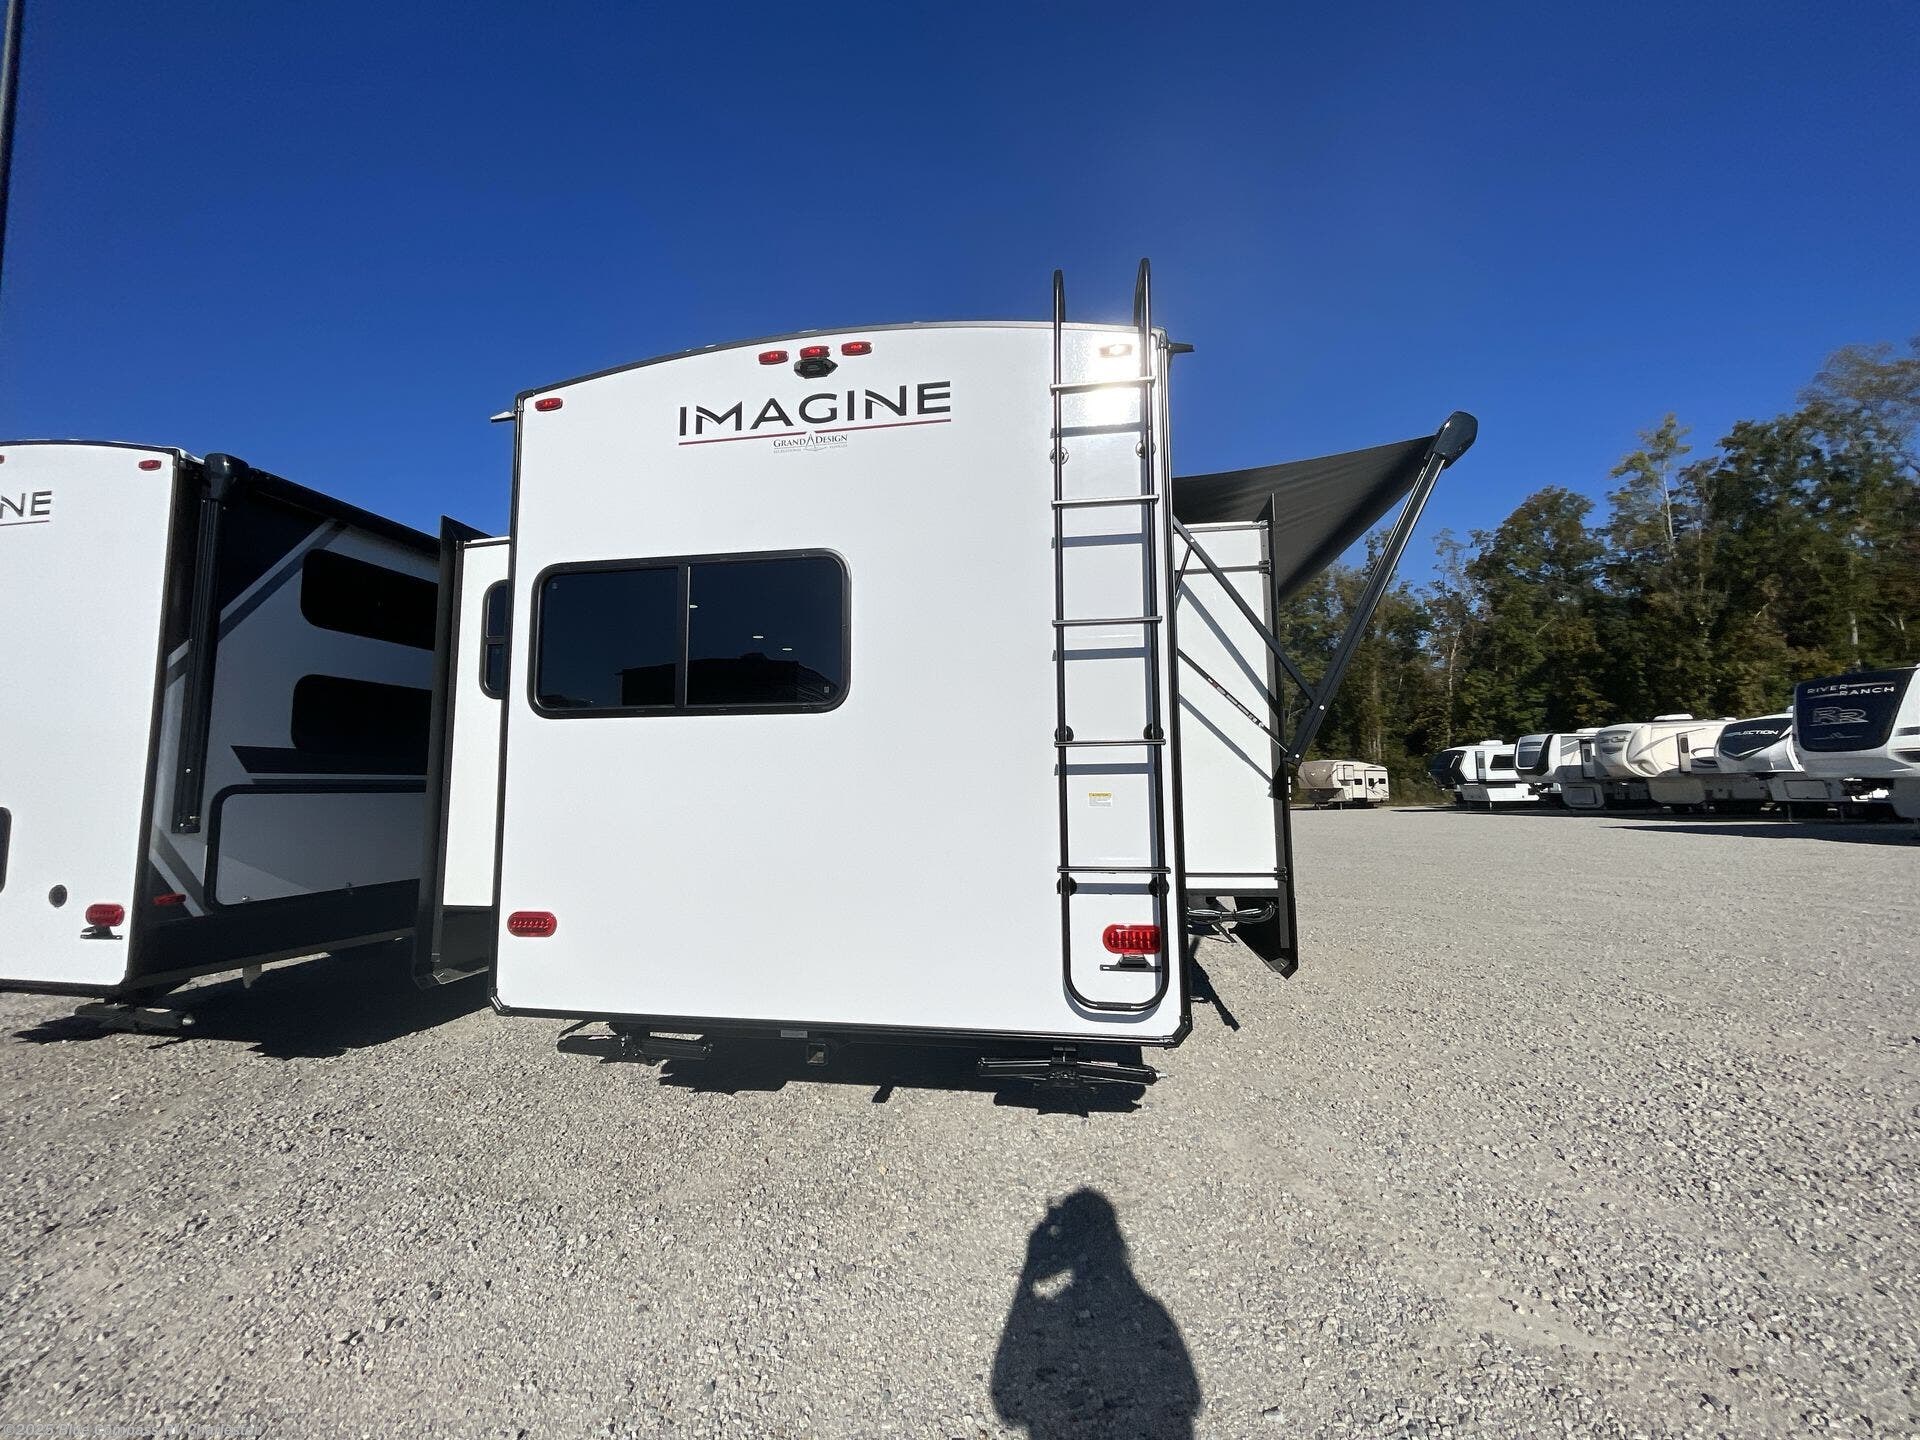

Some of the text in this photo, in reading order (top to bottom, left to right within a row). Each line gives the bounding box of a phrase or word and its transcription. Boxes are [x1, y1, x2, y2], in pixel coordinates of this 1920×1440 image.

[679, 380, 951, 436] IMAGINE
[773, 434, 848, 448] GRAND DESIGN
[1807, 684, 1848, 694] RIVER
[1839, 686, 1895, 696] RANCH
